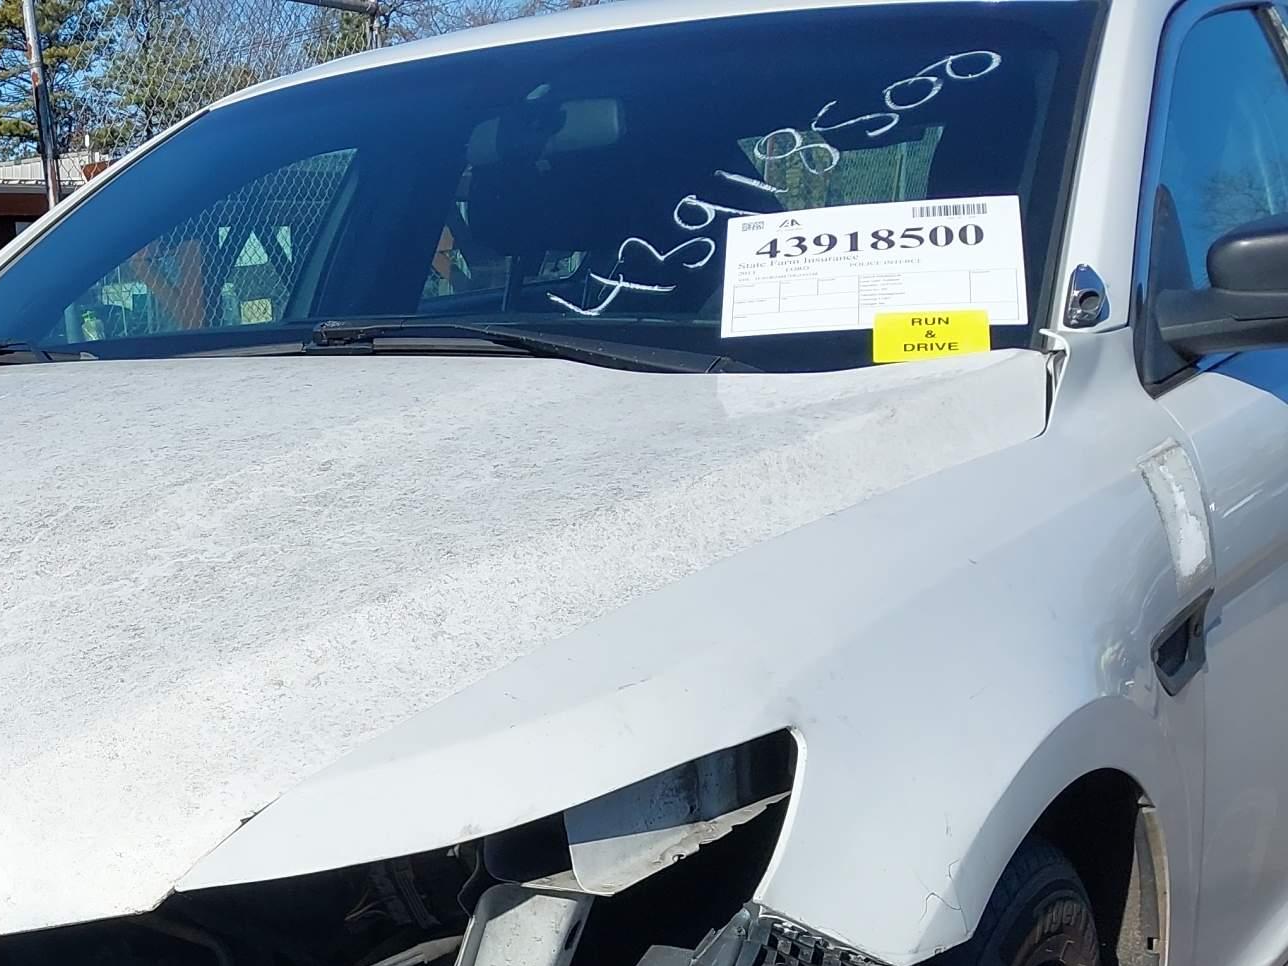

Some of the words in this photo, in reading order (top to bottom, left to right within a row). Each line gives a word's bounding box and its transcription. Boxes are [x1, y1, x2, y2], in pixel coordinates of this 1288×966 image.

[755, 223, 985, 258] 43918500
[737, 262, 767, 270] State
[770, 259, 799, 267] Farm
[804, 254, 859, 265] Insurance
[911, 317, 950, 326] RUN
[924, 330, 936, 338] &
[903, 342, 960, 352] DRIVE
